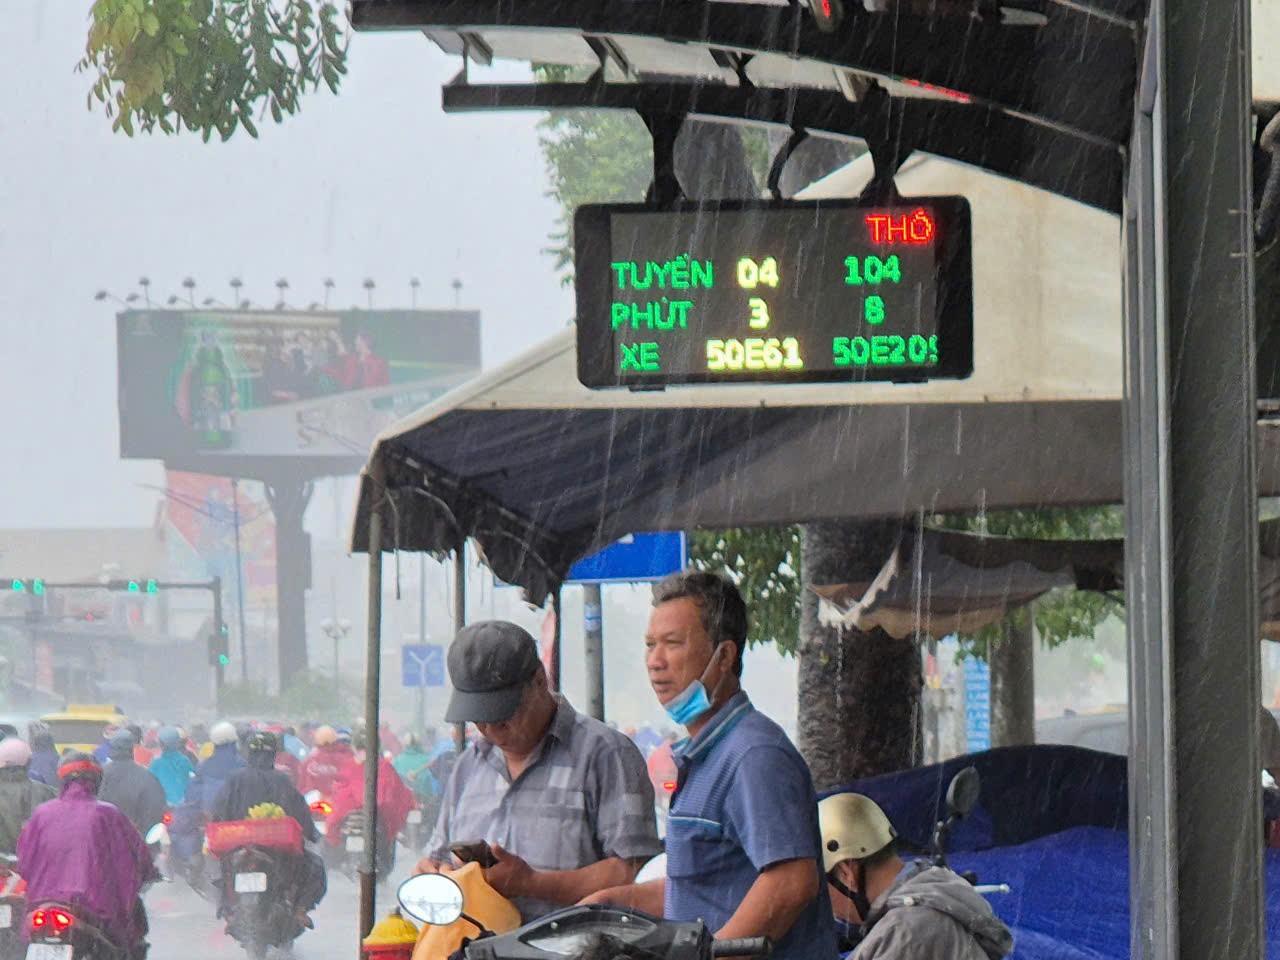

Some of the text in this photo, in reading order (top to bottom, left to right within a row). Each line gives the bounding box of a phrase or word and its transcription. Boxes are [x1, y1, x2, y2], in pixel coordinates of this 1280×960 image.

[737, 257, 779, 288] 04
[845, 255, 901, 285] 104
[749, 298, 769, 329] 3
[620, 342, 660, 371] XE
[706, 338, 803, 371] 50E61
